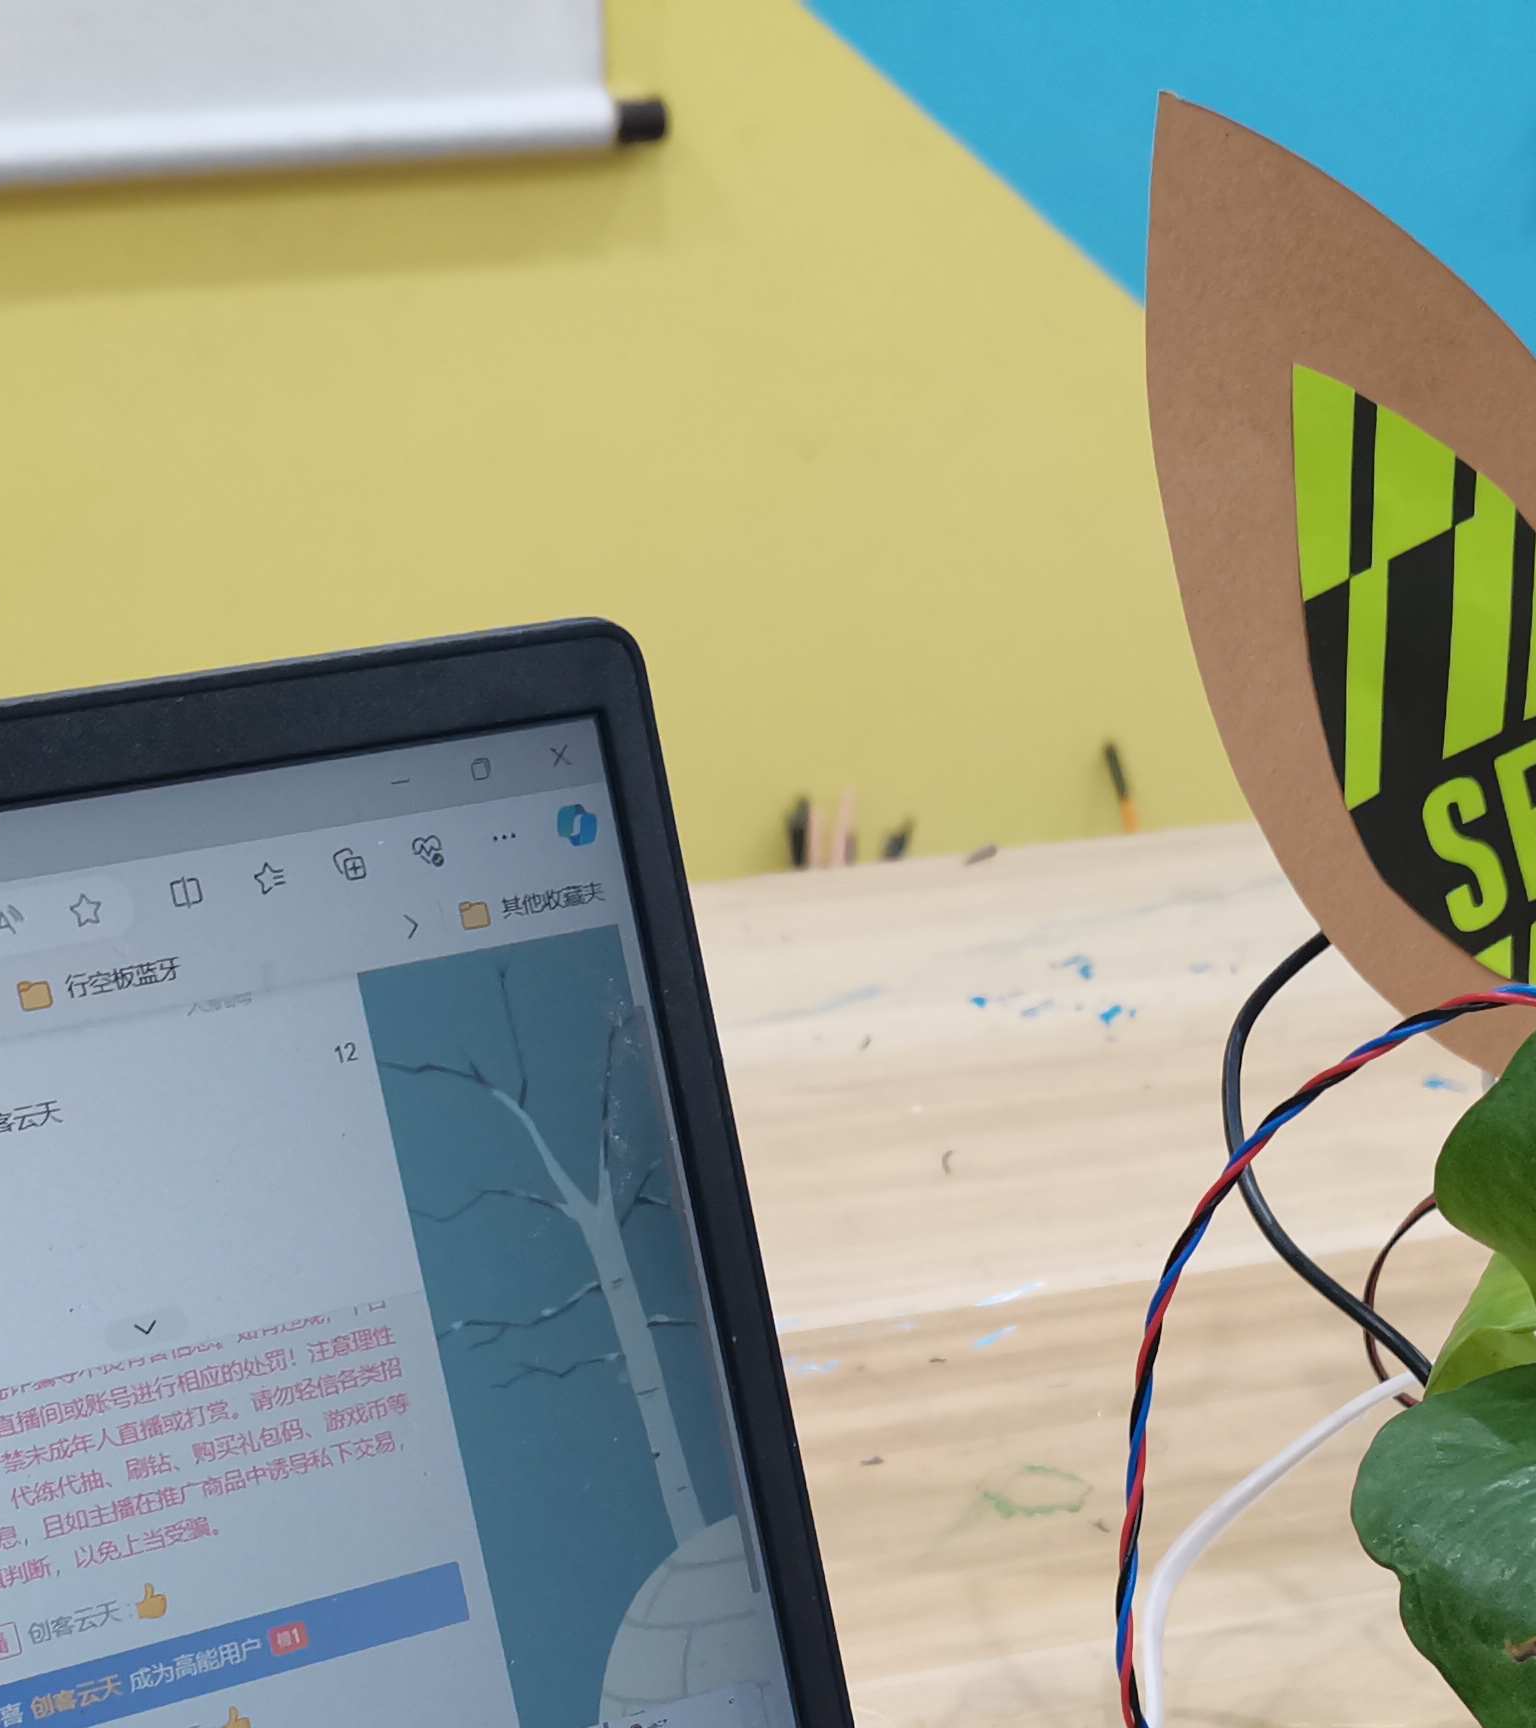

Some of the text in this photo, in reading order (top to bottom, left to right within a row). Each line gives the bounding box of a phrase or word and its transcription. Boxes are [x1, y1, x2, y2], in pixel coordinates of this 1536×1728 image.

[501, 881, 606, 919] 其他收藏夹
[66, 957, 180, 1000] 行空板蓝牙
[334, 1042, 359, 1064] 12
[28, 1600, 121, 1645] 创客云天
[30, 1673, 122, 1720] 创客云天
[130, 1637, 262, 1693] 成为高能用户
